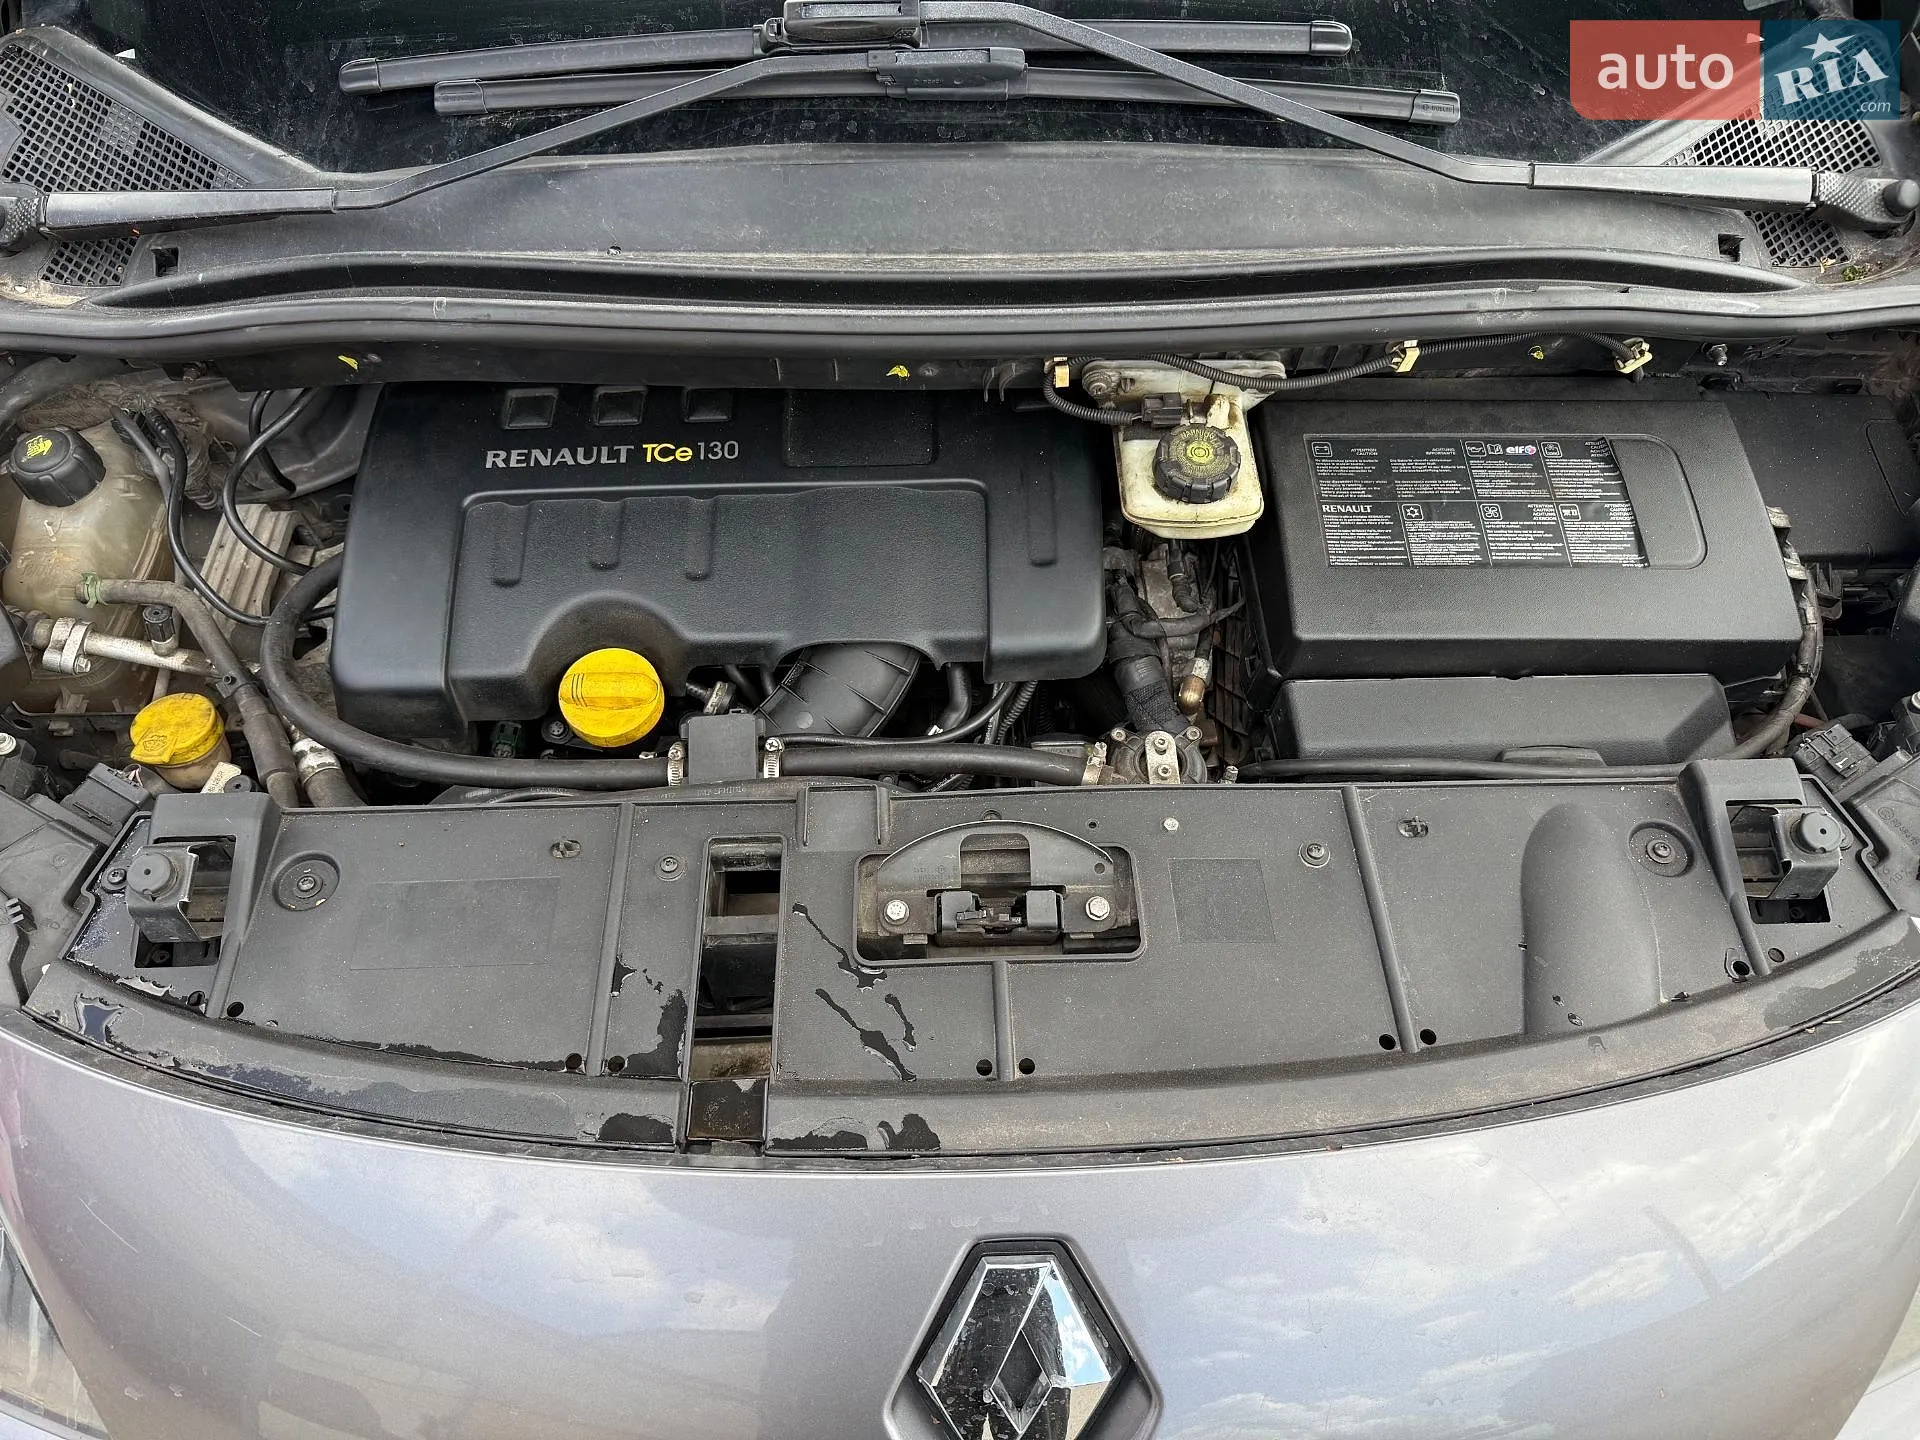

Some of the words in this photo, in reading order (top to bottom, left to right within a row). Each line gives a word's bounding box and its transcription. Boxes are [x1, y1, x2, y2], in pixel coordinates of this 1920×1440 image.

[1506, 445, 1525, 454] elf
[485, 445, 635, 469] RENAULT
[642, 443, 693, 463] TCe
[697, 440, 739, 461] 130
[1322, 504, 1373, 513] RENAULT
